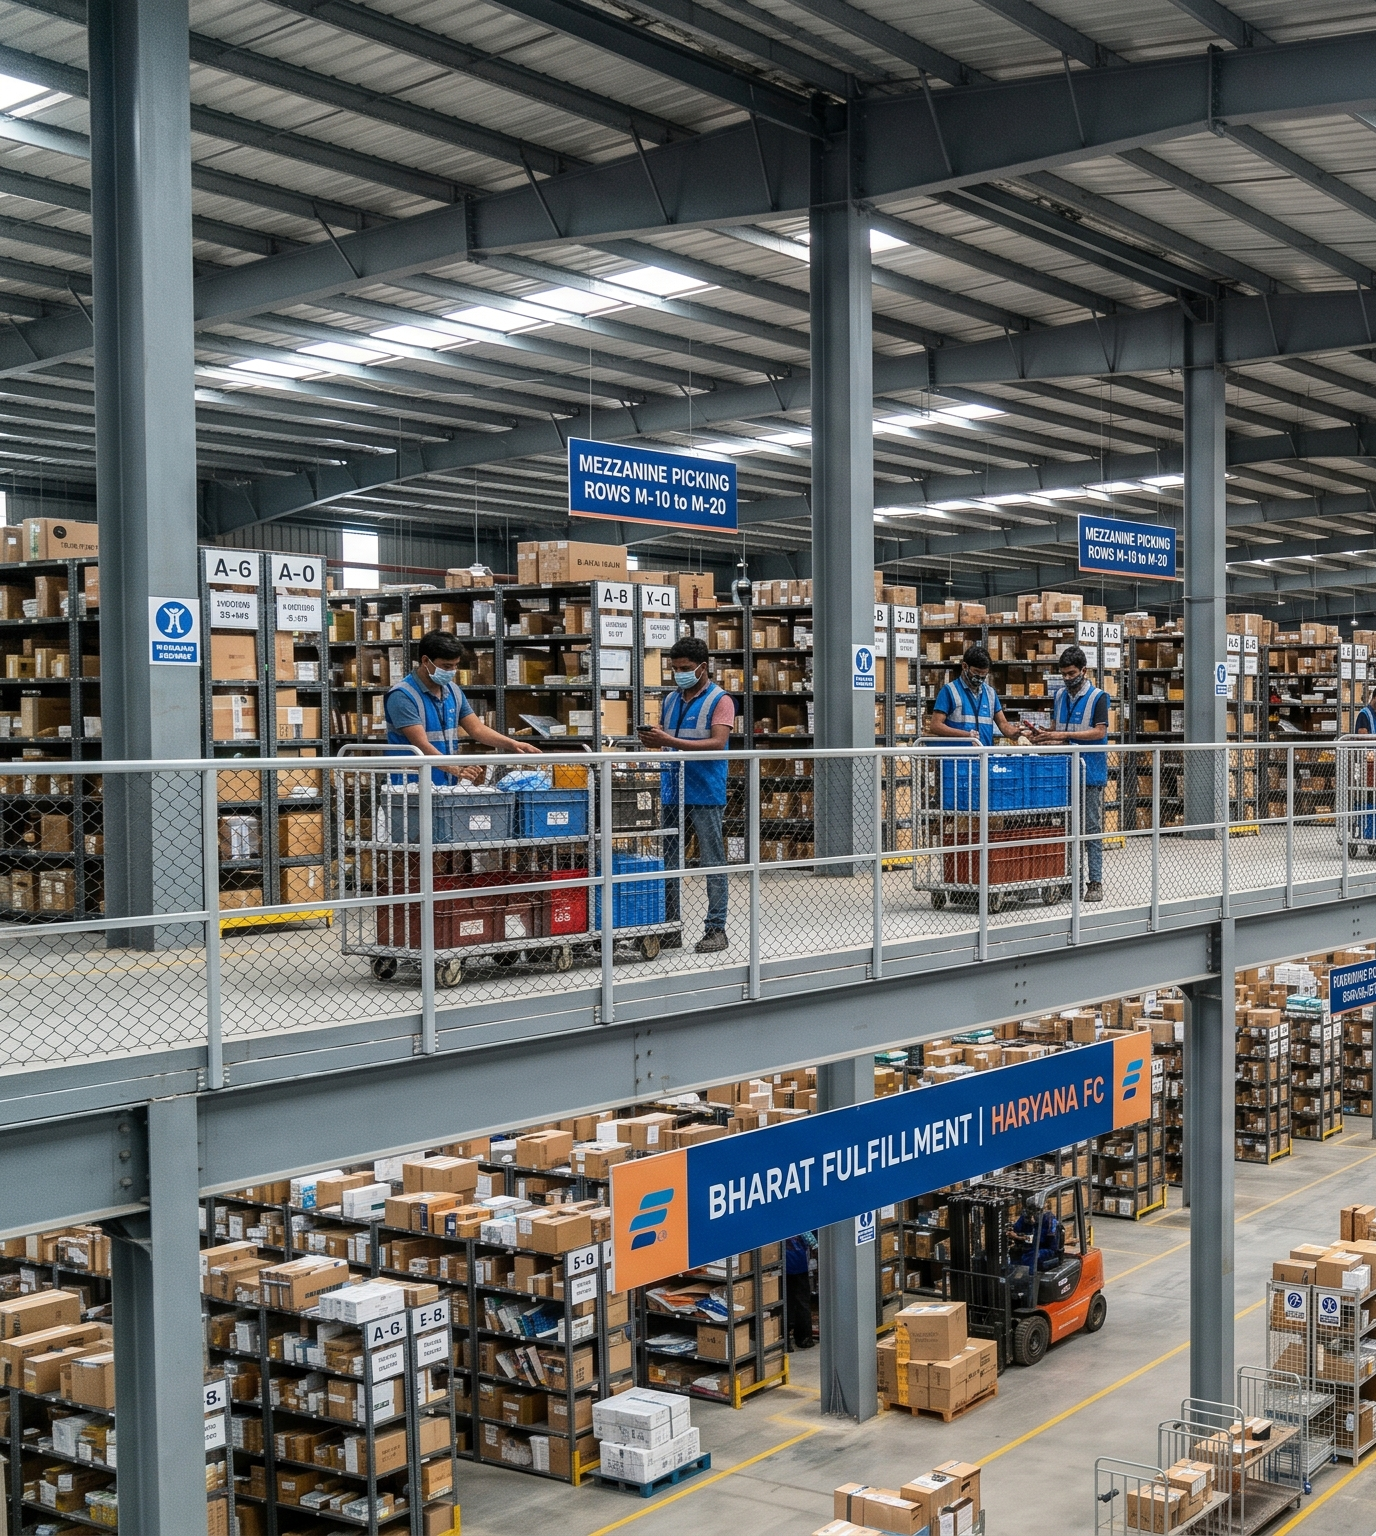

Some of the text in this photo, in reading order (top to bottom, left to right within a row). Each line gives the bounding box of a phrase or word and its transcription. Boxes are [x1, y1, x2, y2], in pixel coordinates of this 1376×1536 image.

[579, 454, 730, 492] MEZZANINE PICKING
[584, 481, 726, 515] ROWS M-10 to M-20
[1085, 527, 1170, 550] MEZZANINE PICKING
[1088, 545, 1114, 560] ROWS
[1138, 553, 1146, 564] to
[1148, 553, 1167, 567] M-20
[214, 558, 252, 578] A-6
[874, 610, 884, 621] -B
[709, 1075, 1105, 1220] BHARAT FULFILLMENT HARYANA FC
